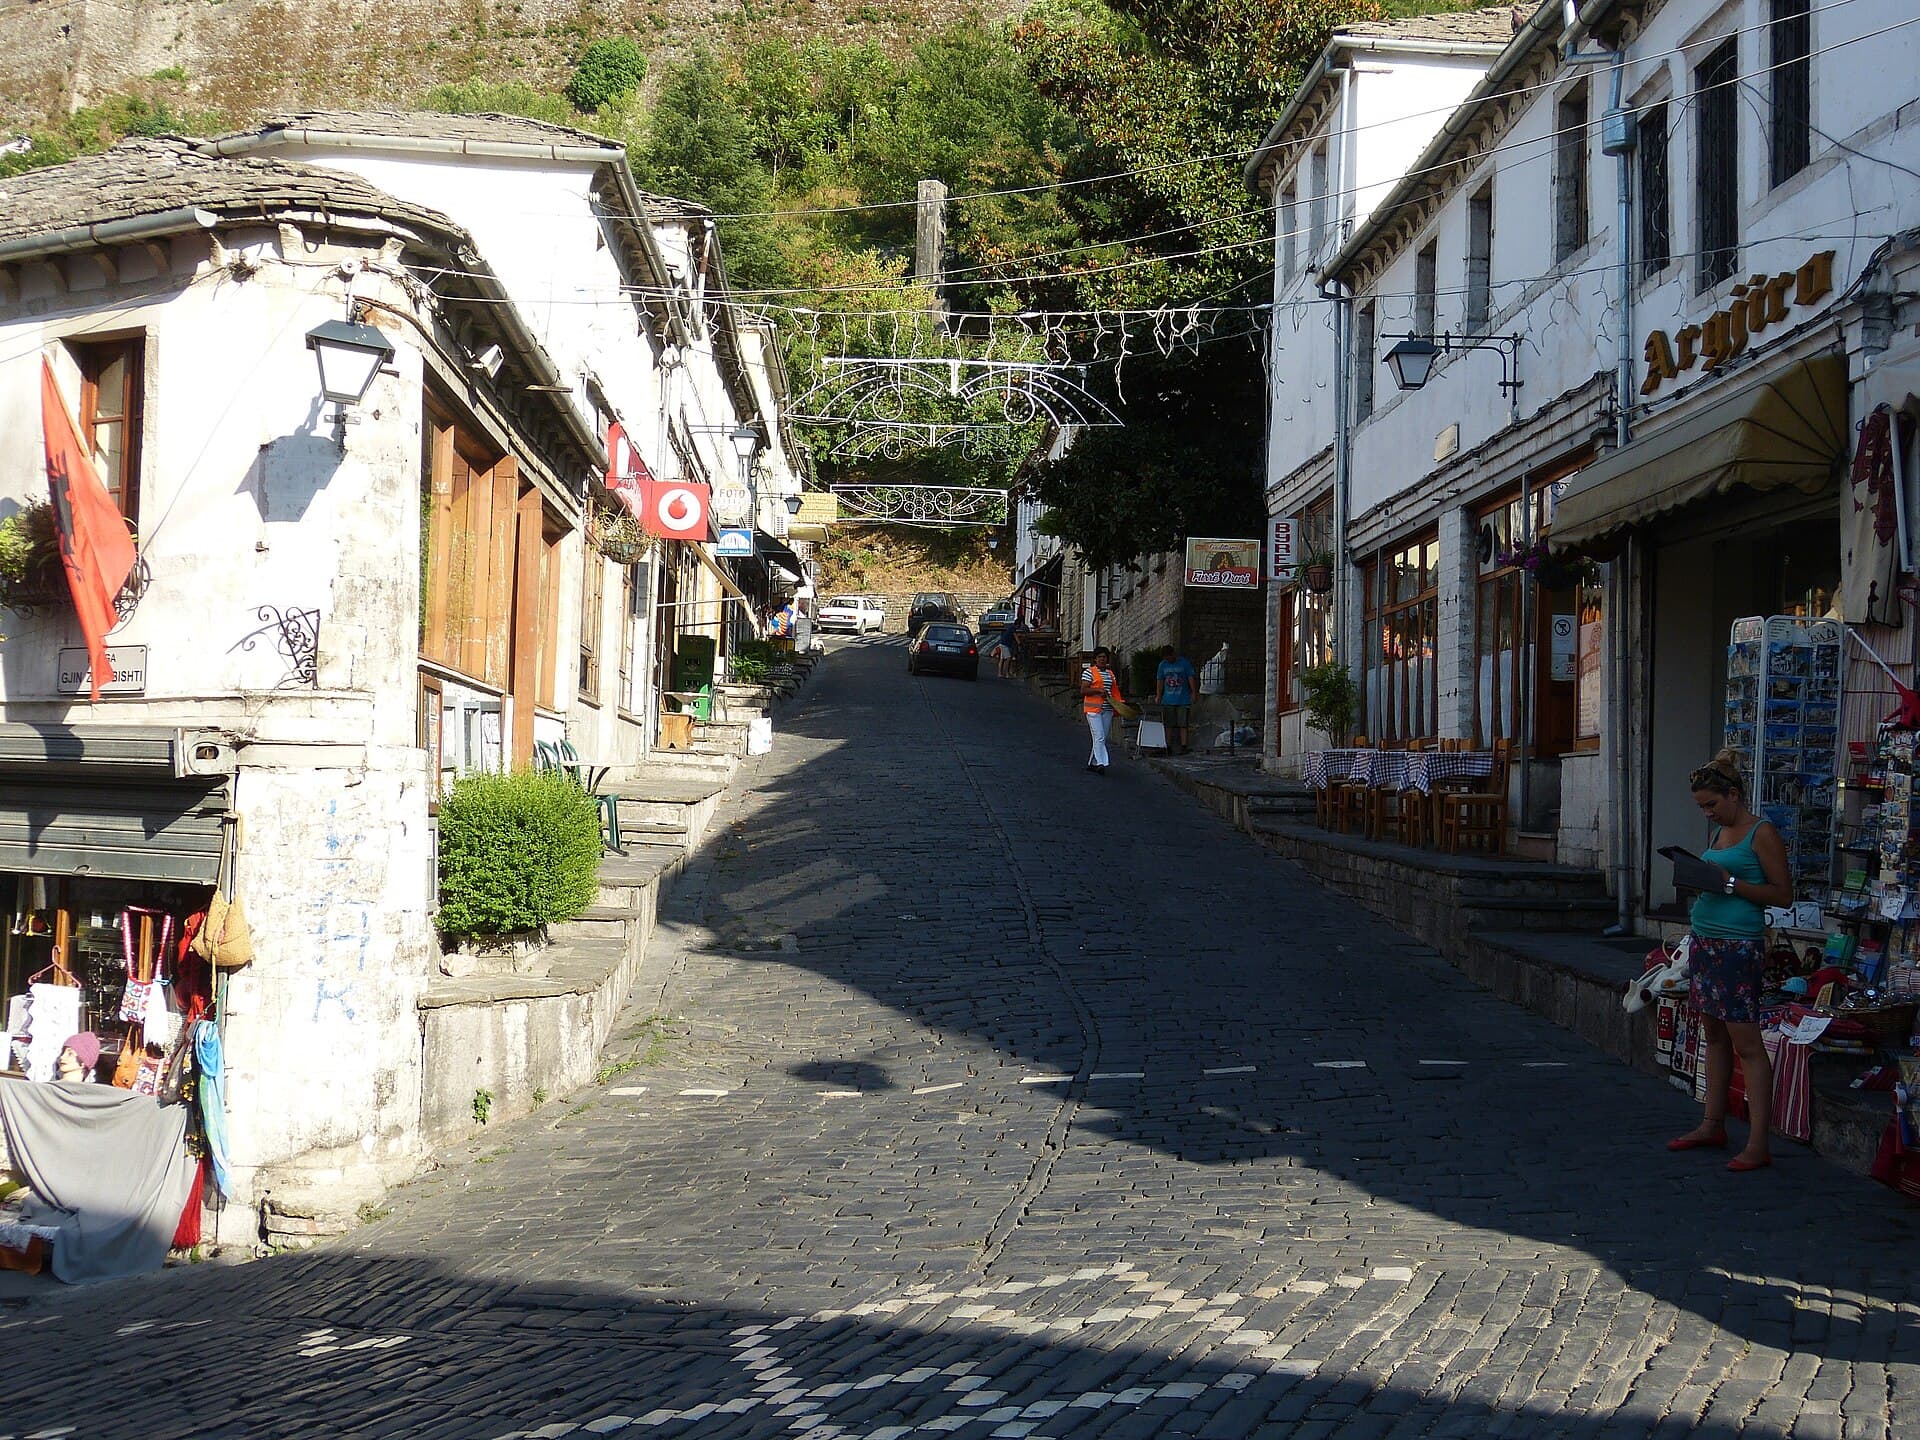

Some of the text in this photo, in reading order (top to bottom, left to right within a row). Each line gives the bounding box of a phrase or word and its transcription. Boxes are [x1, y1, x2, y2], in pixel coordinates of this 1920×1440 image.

[1640, 250, 1836, 395] Argjiro
[719, 488, 746, 499] FOTO
[1274, 522, 1291, 577] BYREK
[61, 670, 143, 684] GJIN ZBISHTI
